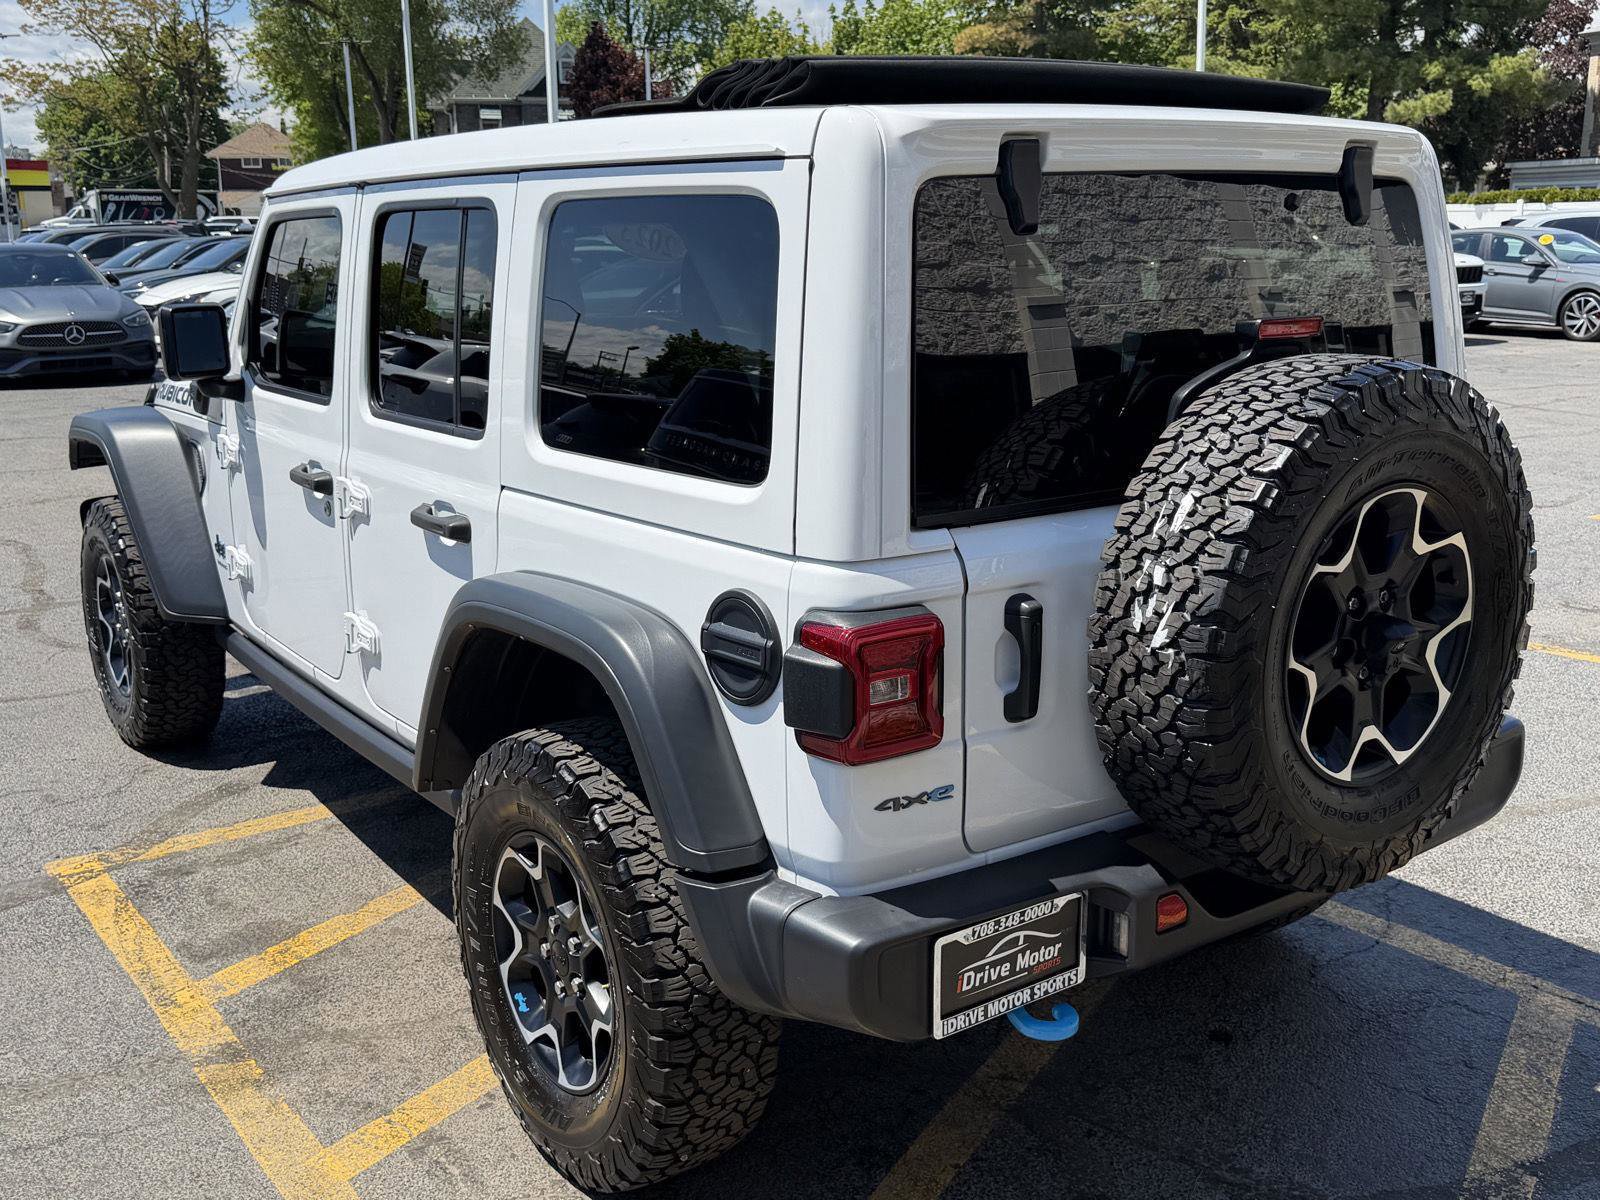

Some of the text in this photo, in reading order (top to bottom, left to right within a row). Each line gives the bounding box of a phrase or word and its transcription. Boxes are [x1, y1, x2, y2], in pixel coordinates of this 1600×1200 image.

[973, 902, 1052, 939] 708-348-0000
[956, 943, 1062, 993] iDrive Motor
[1033, 956, 1062, 974] SPORTS
[988, 988, 1031, 1016] MOTOR
[1033, 970, 1077, 1000] SPORTS
